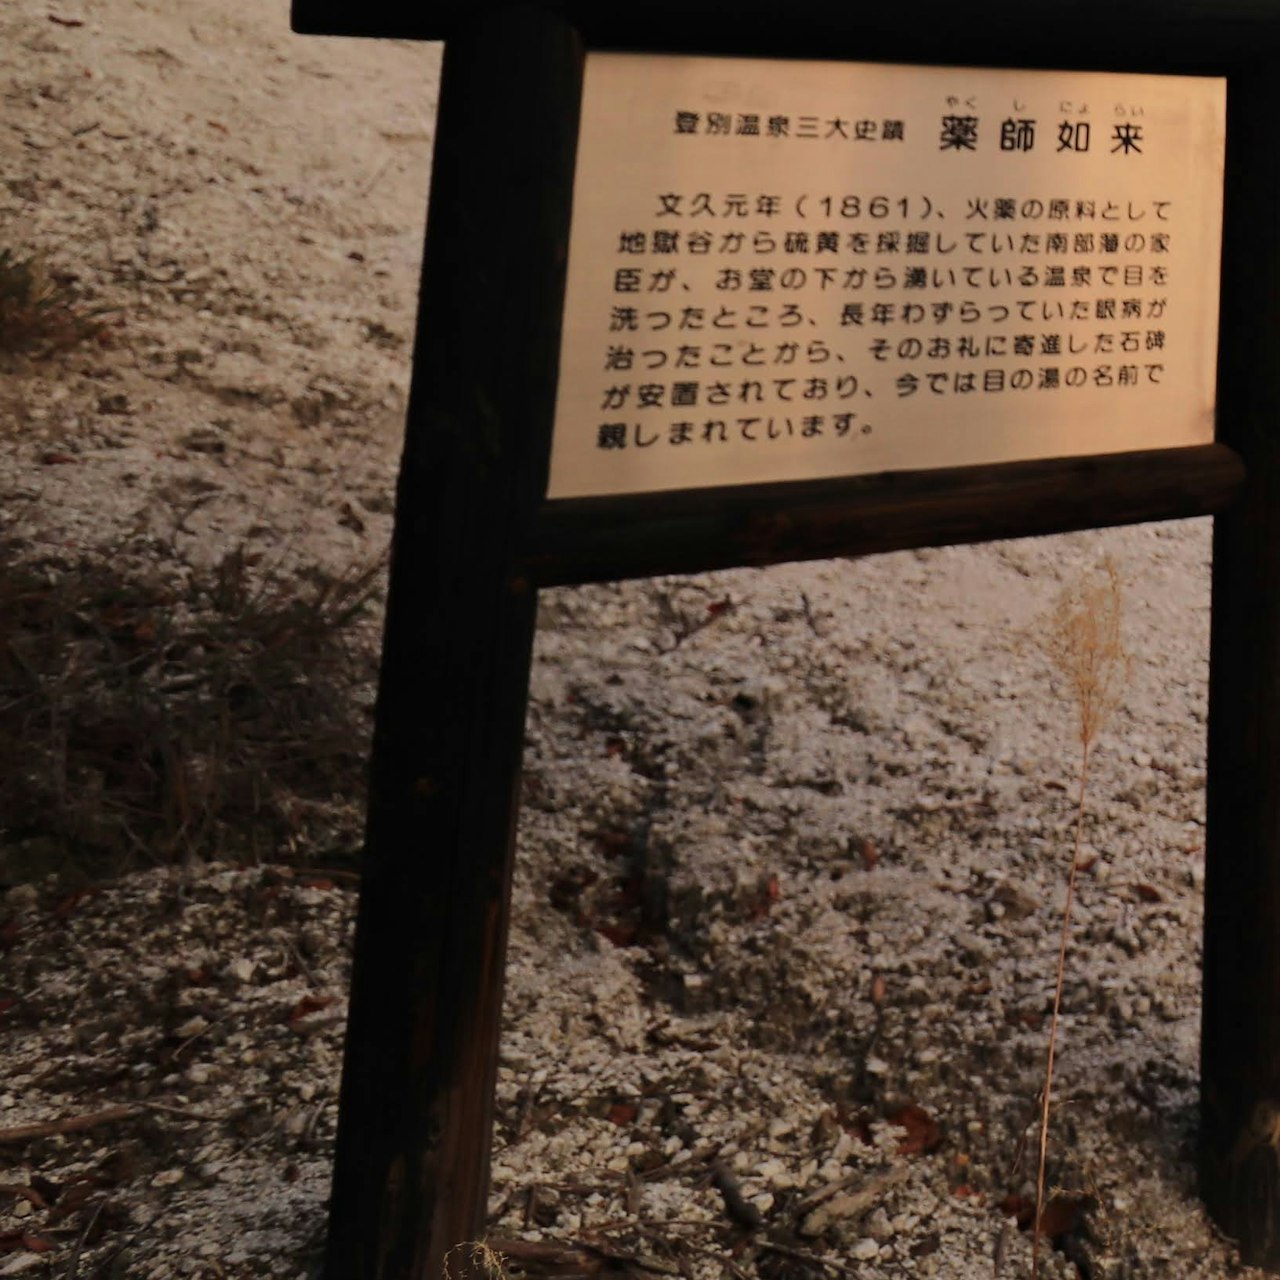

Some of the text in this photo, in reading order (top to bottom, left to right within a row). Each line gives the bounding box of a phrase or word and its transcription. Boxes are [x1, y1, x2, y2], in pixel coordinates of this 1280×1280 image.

[938, 113, 1144, 156] 薬師如来
[596, 412, 872, 450] 親しまれています。
